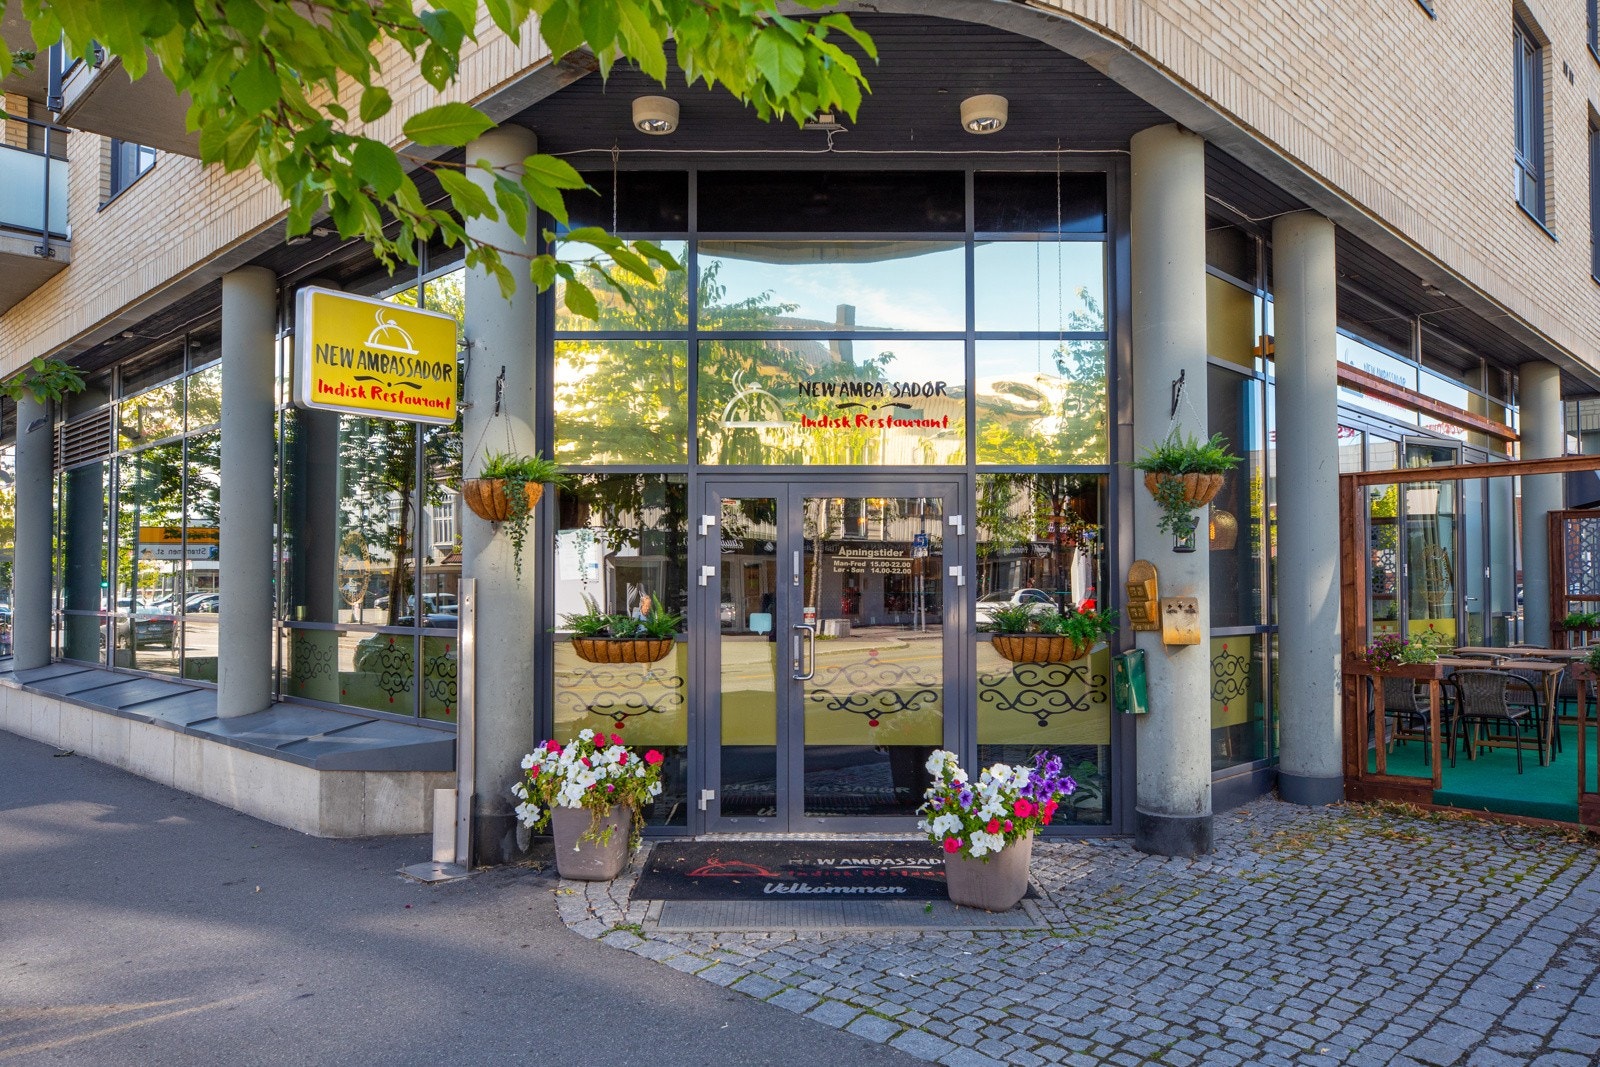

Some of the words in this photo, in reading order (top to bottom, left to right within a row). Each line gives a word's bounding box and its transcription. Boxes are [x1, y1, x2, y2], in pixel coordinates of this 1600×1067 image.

[316, 343, 354, 369] NEW
[356, 350, 453, 383] AMBASSADØR
[318, 378, 367, 399] Indisk
[370, 385, 451, 410] Restaurant
[799, 381, 836, 398] NEW
[801, 414, 852, 429] Indisk
[855, 413, 949, 430] Restaurant
[839, 858, 946, 866] AMBASSAD
[763, 882, 907, 894] Velkommen
